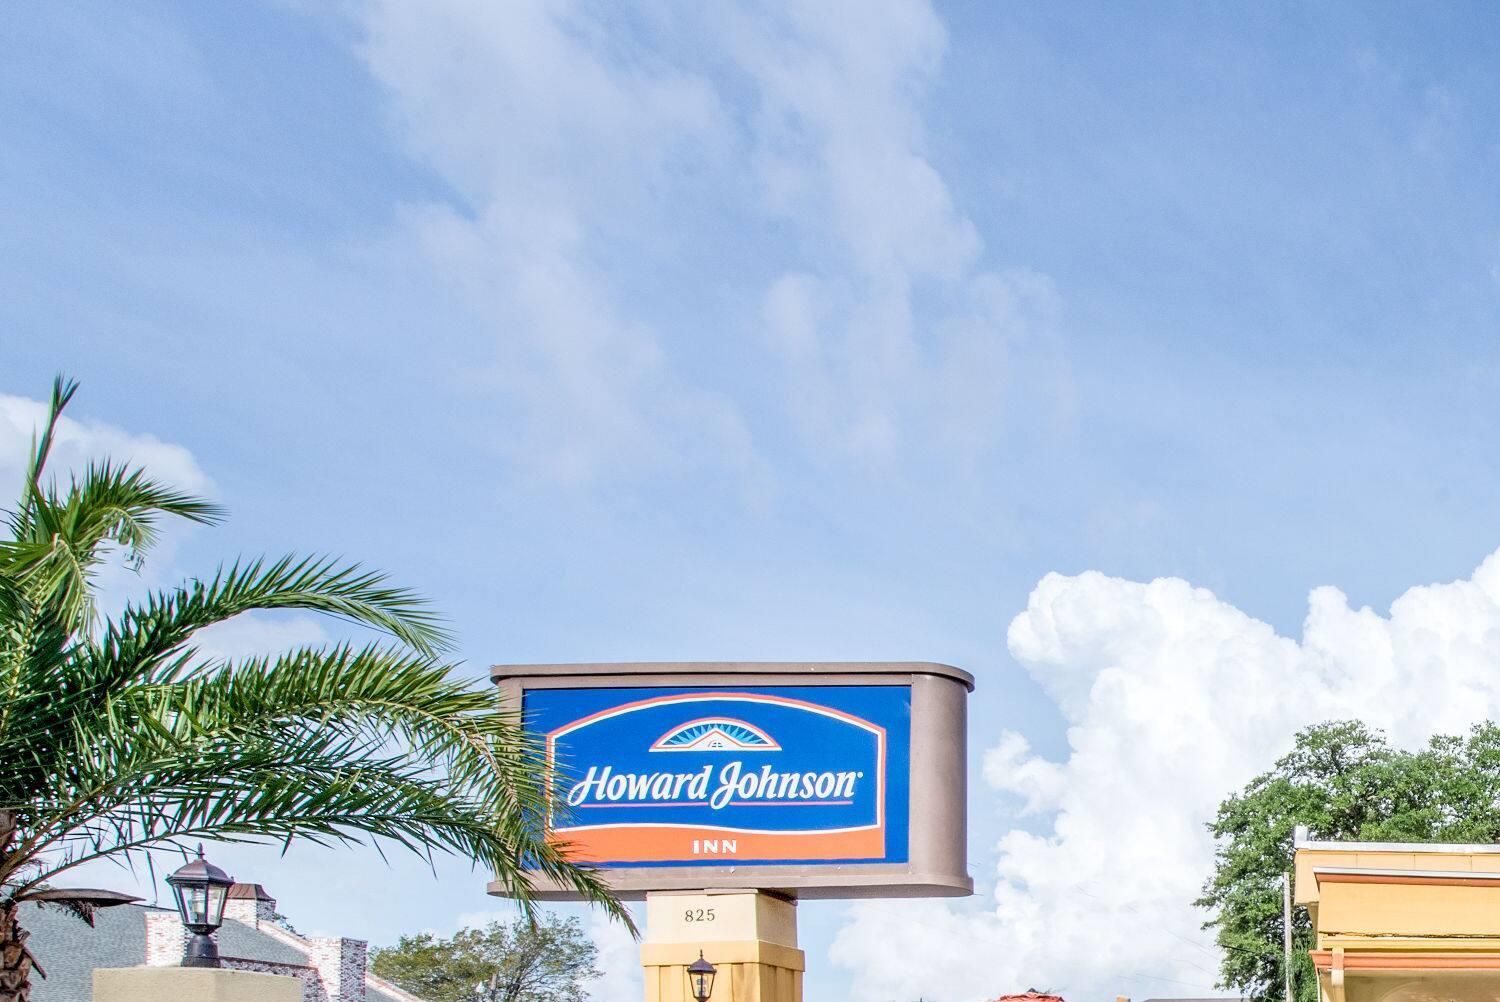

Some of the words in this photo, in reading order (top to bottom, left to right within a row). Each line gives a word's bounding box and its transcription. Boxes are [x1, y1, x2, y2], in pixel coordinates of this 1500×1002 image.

[567, 764, 714, 807] Howard
[709, 761, 858, 810] Johnson
[692, 839, 737, 854] INN
[684, 908, 716, 922] 825
